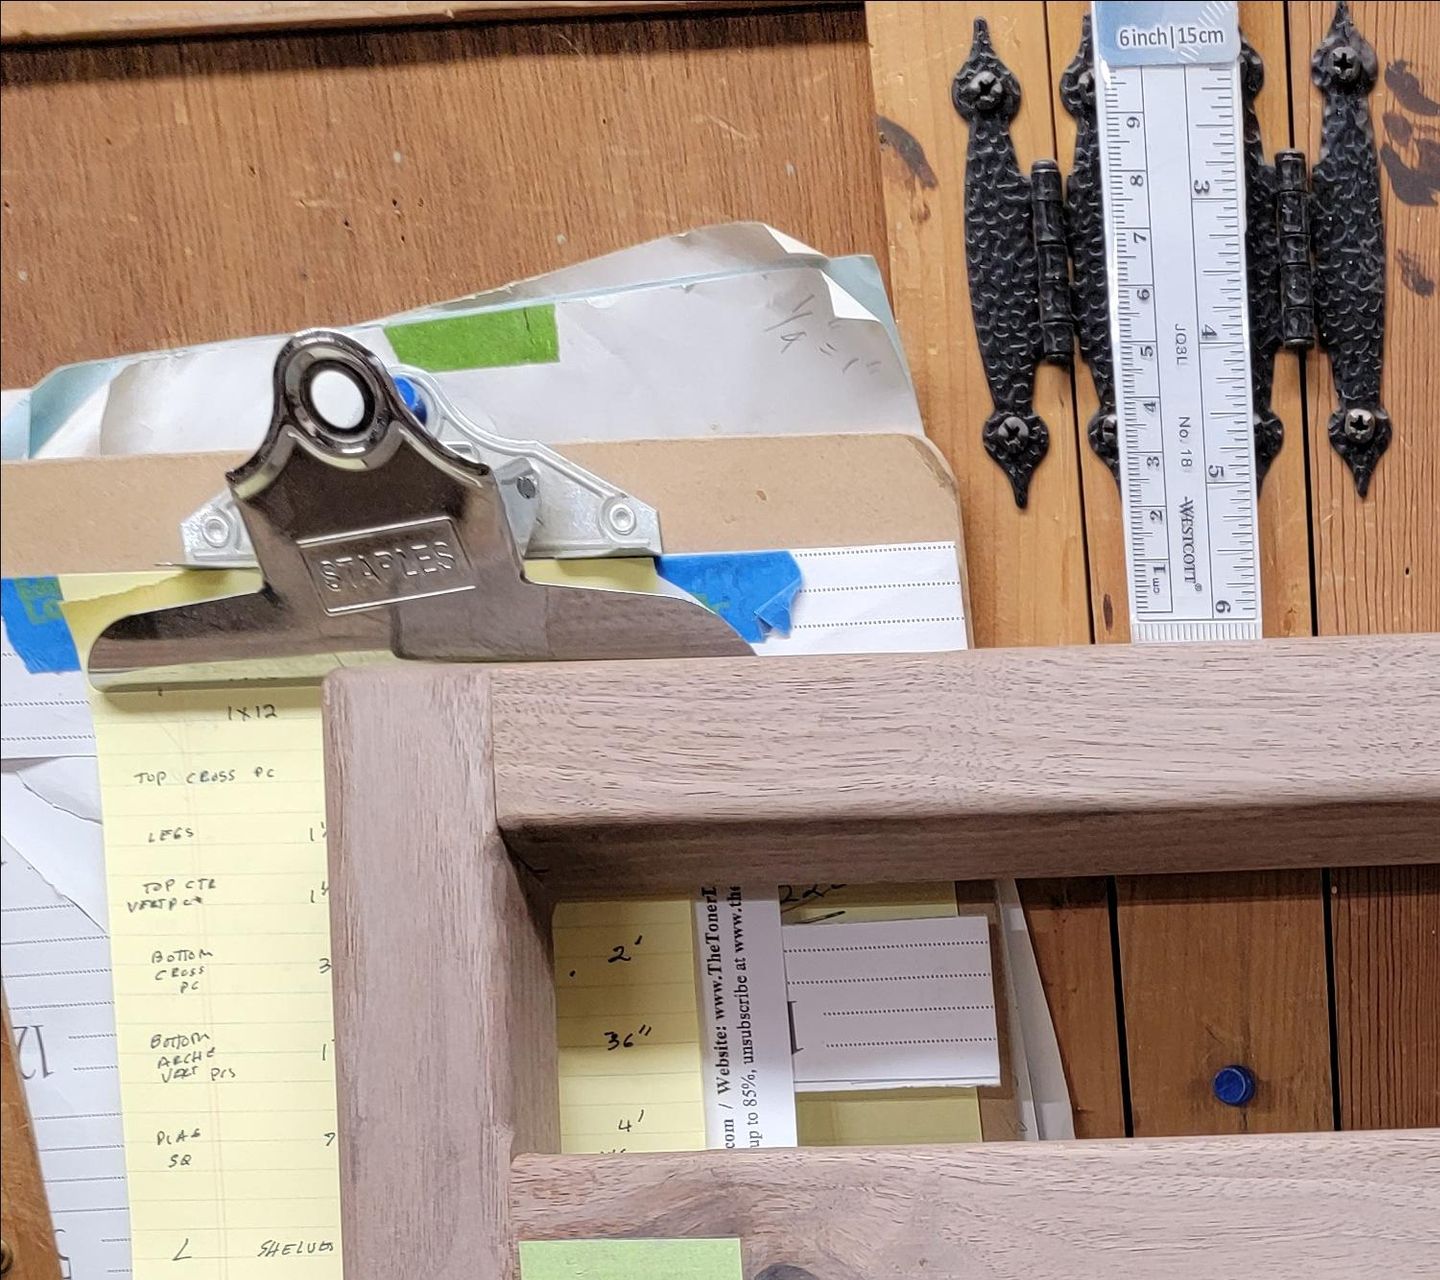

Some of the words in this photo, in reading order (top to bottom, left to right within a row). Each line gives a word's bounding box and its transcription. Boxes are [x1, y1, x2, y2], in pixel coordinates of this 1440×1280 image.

[1126, 115, 1141, 129] 9
[1130, 174, 1144, 187] 8
[1193, 179, 1211, 195] 3
[1133, 232, 1147, 244] 7
[1136, 288, 1150, 301] 6
[1201, 324, 1218, 338] 4
[1140, 345, 1153, 358] 5
[1143, 401, 1157, 414] 4
[1146, 455, 1160, 468] 3
[1180, 449, 1194, 468] 18
[1208, 464, 1225, 478] 5
[1149, 509, 1163, 522] 2
[1178, 496, 1198, 585] WESTCOTT
[320, 541, 455, 592] STAPLES
[1152, 564, 1167, 575] 1
[1152, 577, 1161, 594] cm
[1215, 599, 1232, 614] 6
[135, 771, 167, 786] TOP
[186, 768, 236, 784] CROSS
[253, 767, 276, 779] PC
[148, 828, 195, 843] LEGS
[143, 879, 175, 893] TOP
[734, 955, 747, 971] at
[155, 965, 205, 981] CROSS
[734, 973, 755, 1065] unsubscribe
[715, 1025, 730, 1094] Website:
[741, 1069, 757, 1107] 85%,
[747, 1112, 759, 1130] to
[750, 1132, 763, 1148] up
